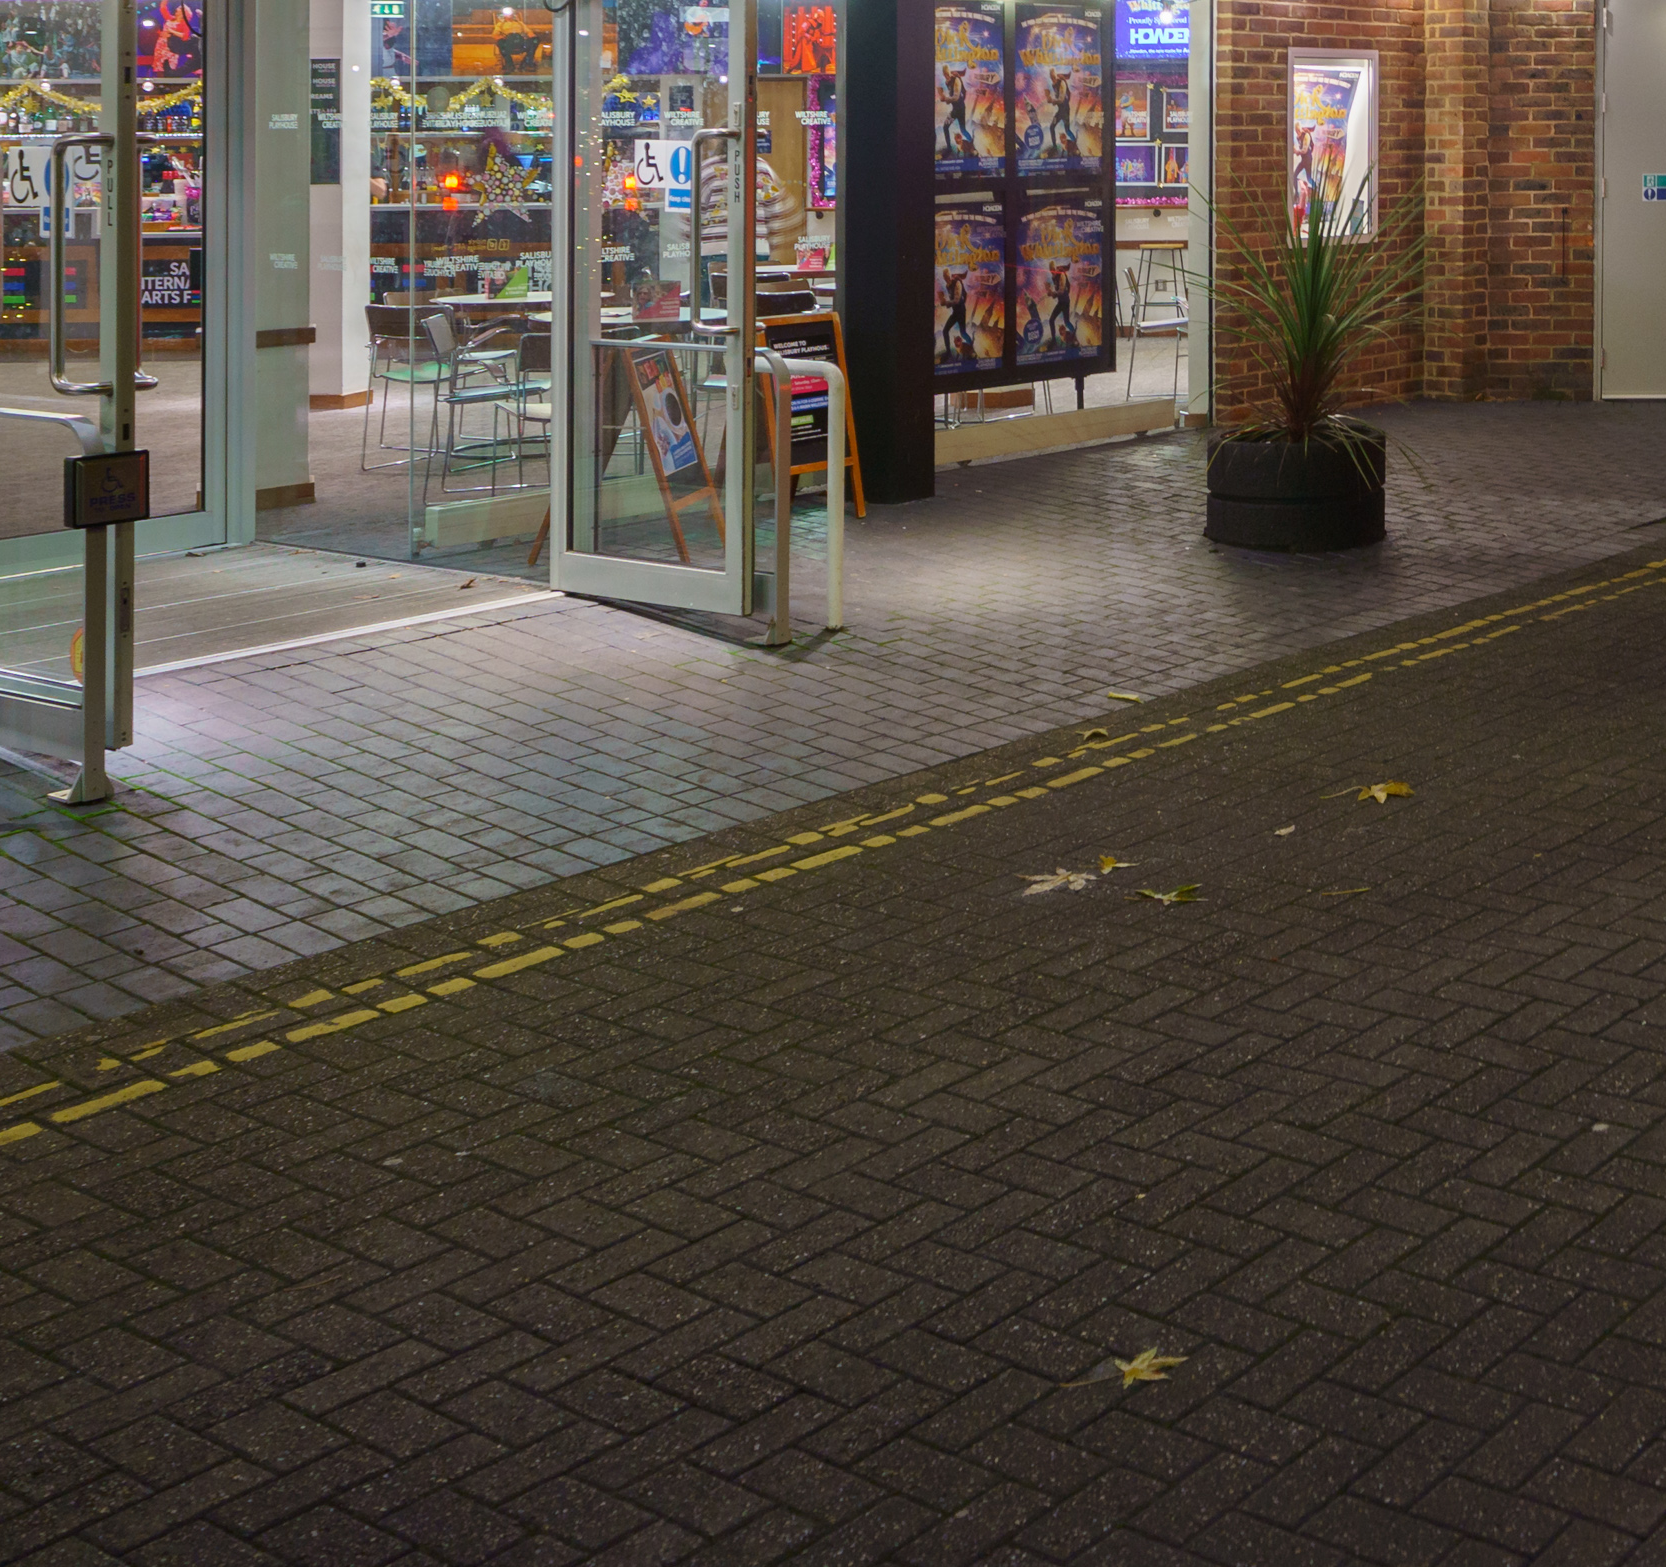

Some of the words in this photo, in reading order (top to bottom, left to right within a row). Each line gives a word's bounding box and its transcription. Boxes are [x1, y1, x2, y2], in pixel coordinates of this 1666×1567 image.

[1154, 16, 1187, 25] Spored
[935, 46, 999, 69] ittington
[664, 111, 700, 119] WILTSHIRE
[599, 118, 635, 126] AYHOUSE
[670, 118, 704, 126] CREATIVE
[682, 195, 691, 203] cle
[602, 245, 631, 254] LTSHIRE
[935, 246, 1000, 271] ittington
[170, 262, 190, 275] SA
[142, 291, 180, 304] ARTS
[773, 340, 799, 349] WELCOME
[779, 348, 801, 356] LISBURY
[89, 492, 136, 507] PRESS
